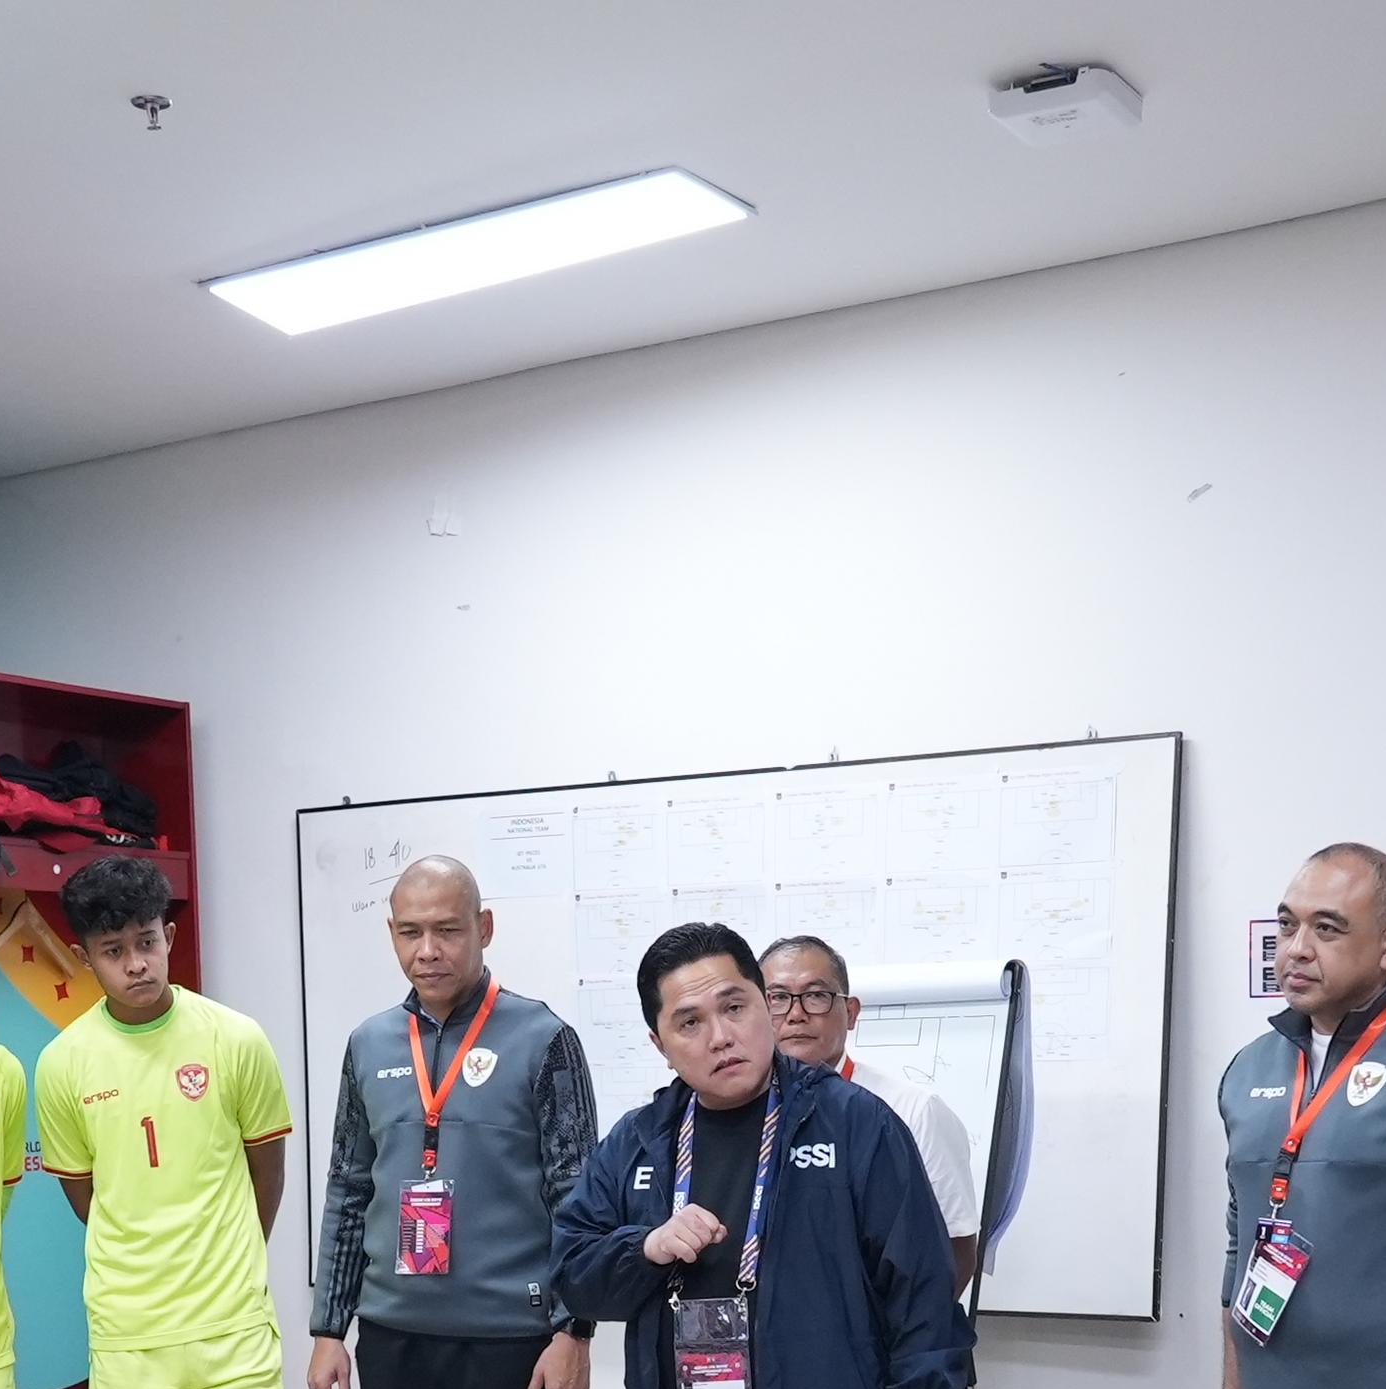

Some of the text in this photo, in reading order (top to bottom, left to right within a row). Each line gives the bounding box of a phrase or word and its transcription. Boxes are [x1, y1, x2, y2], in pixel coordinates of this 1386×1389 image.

[376, 1066, 413, 1079] erspo
[83, 1088, 119, 1105] erspo
[1250, 1086, 1287, 1099] erspo
[140, 1116, 159, 1168] 1
